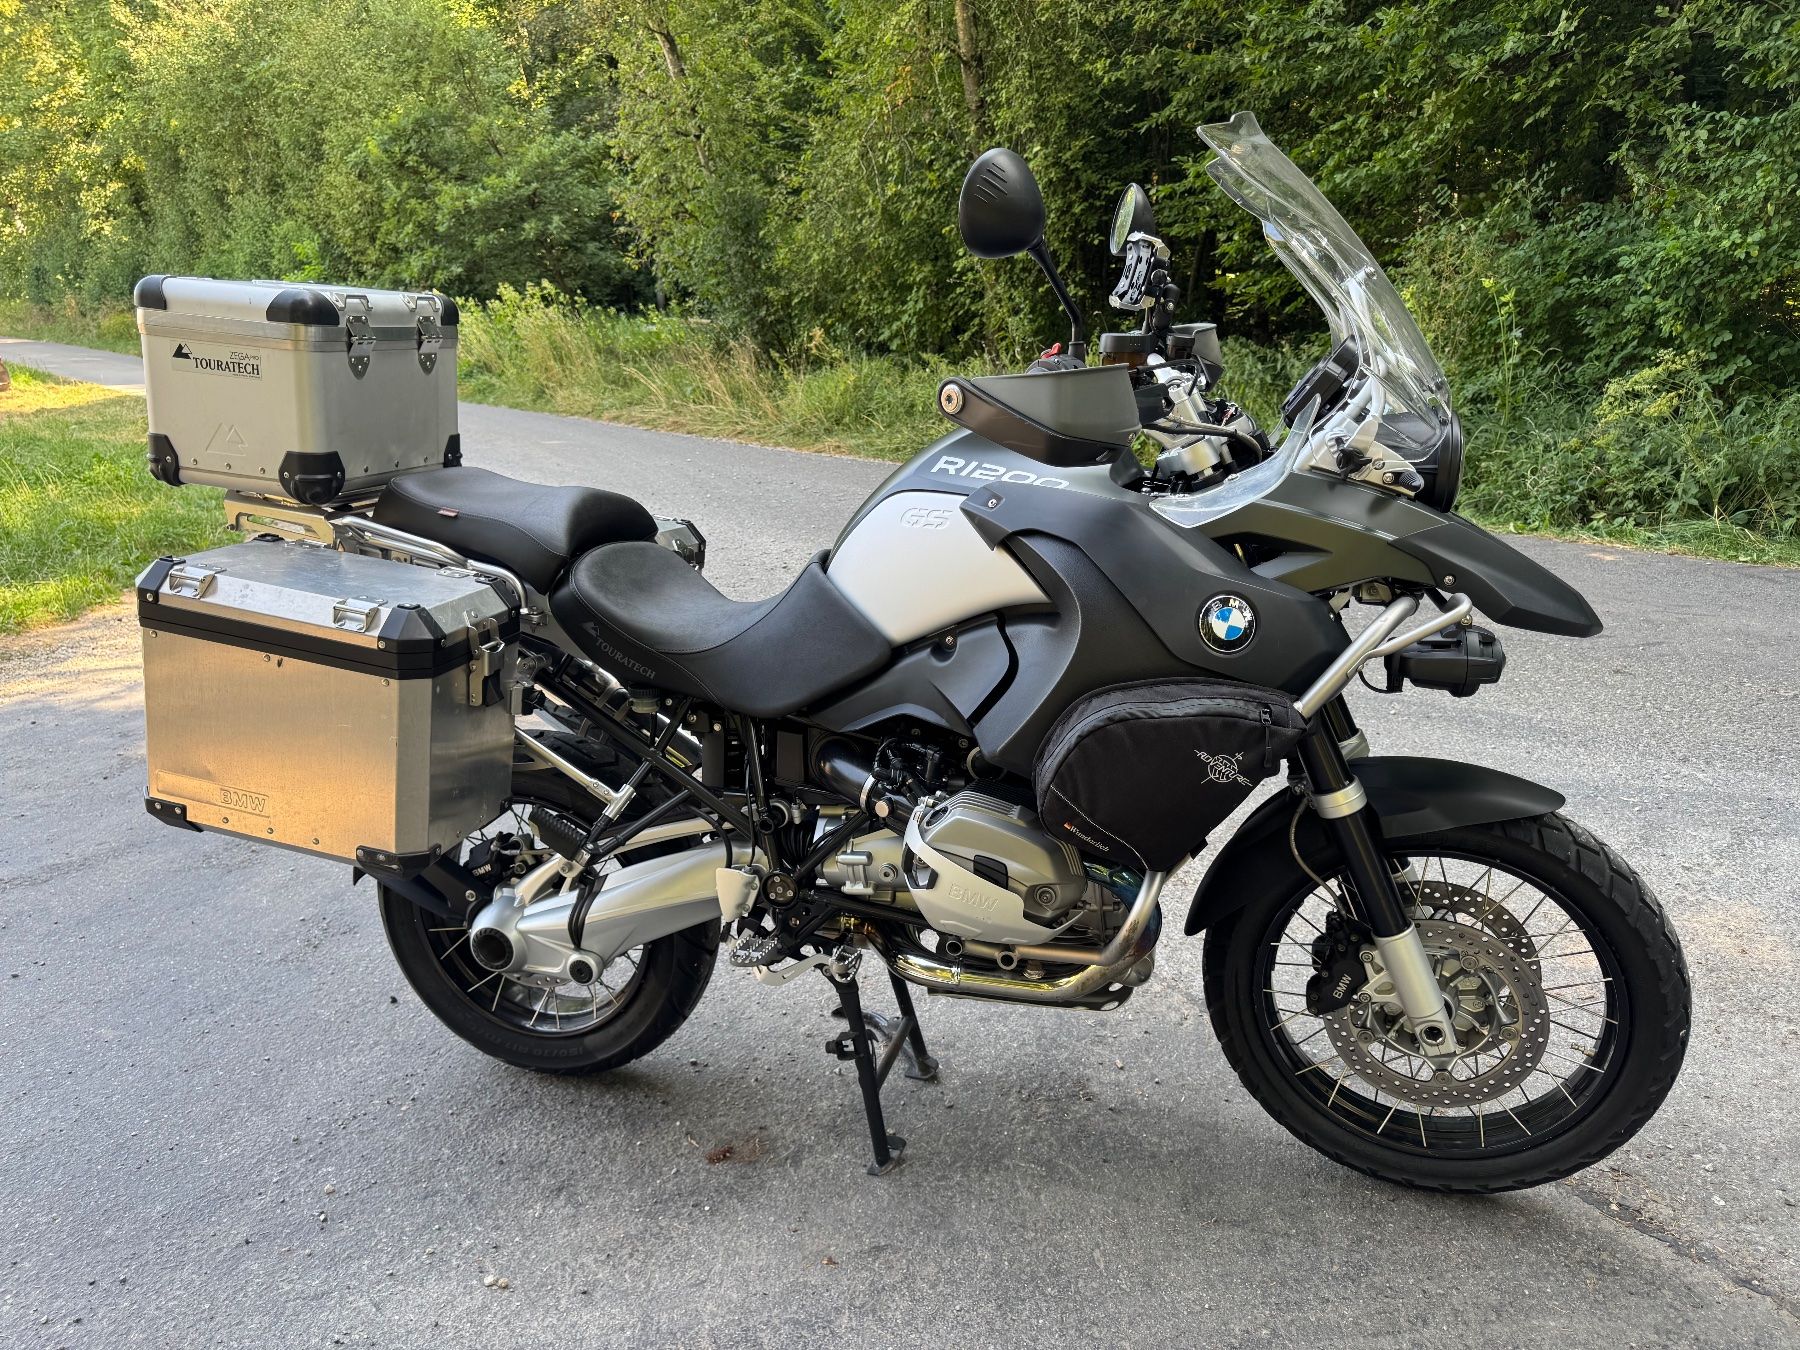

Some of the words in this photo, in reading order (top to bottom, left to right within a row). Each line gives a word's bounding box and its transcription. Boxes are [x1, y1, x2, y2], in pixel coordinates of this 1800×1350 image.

[192, 356, 261, 376] TOURATECH
[930, 455, 1070, 489] R1200
[900, 507, 953, 530] GS
[596, 636, 656, 681] TOURATECH
[1193, 749, 1253, 787] ADVENTURE
[219, 787, 266, 813] BMW
[1070, 825, 1110, 852] Wunderlich
[471, 863, 492, 877] BMW
[948, 883, 999, 912] BMW
[1332, 973, 1352, 999] BMW
